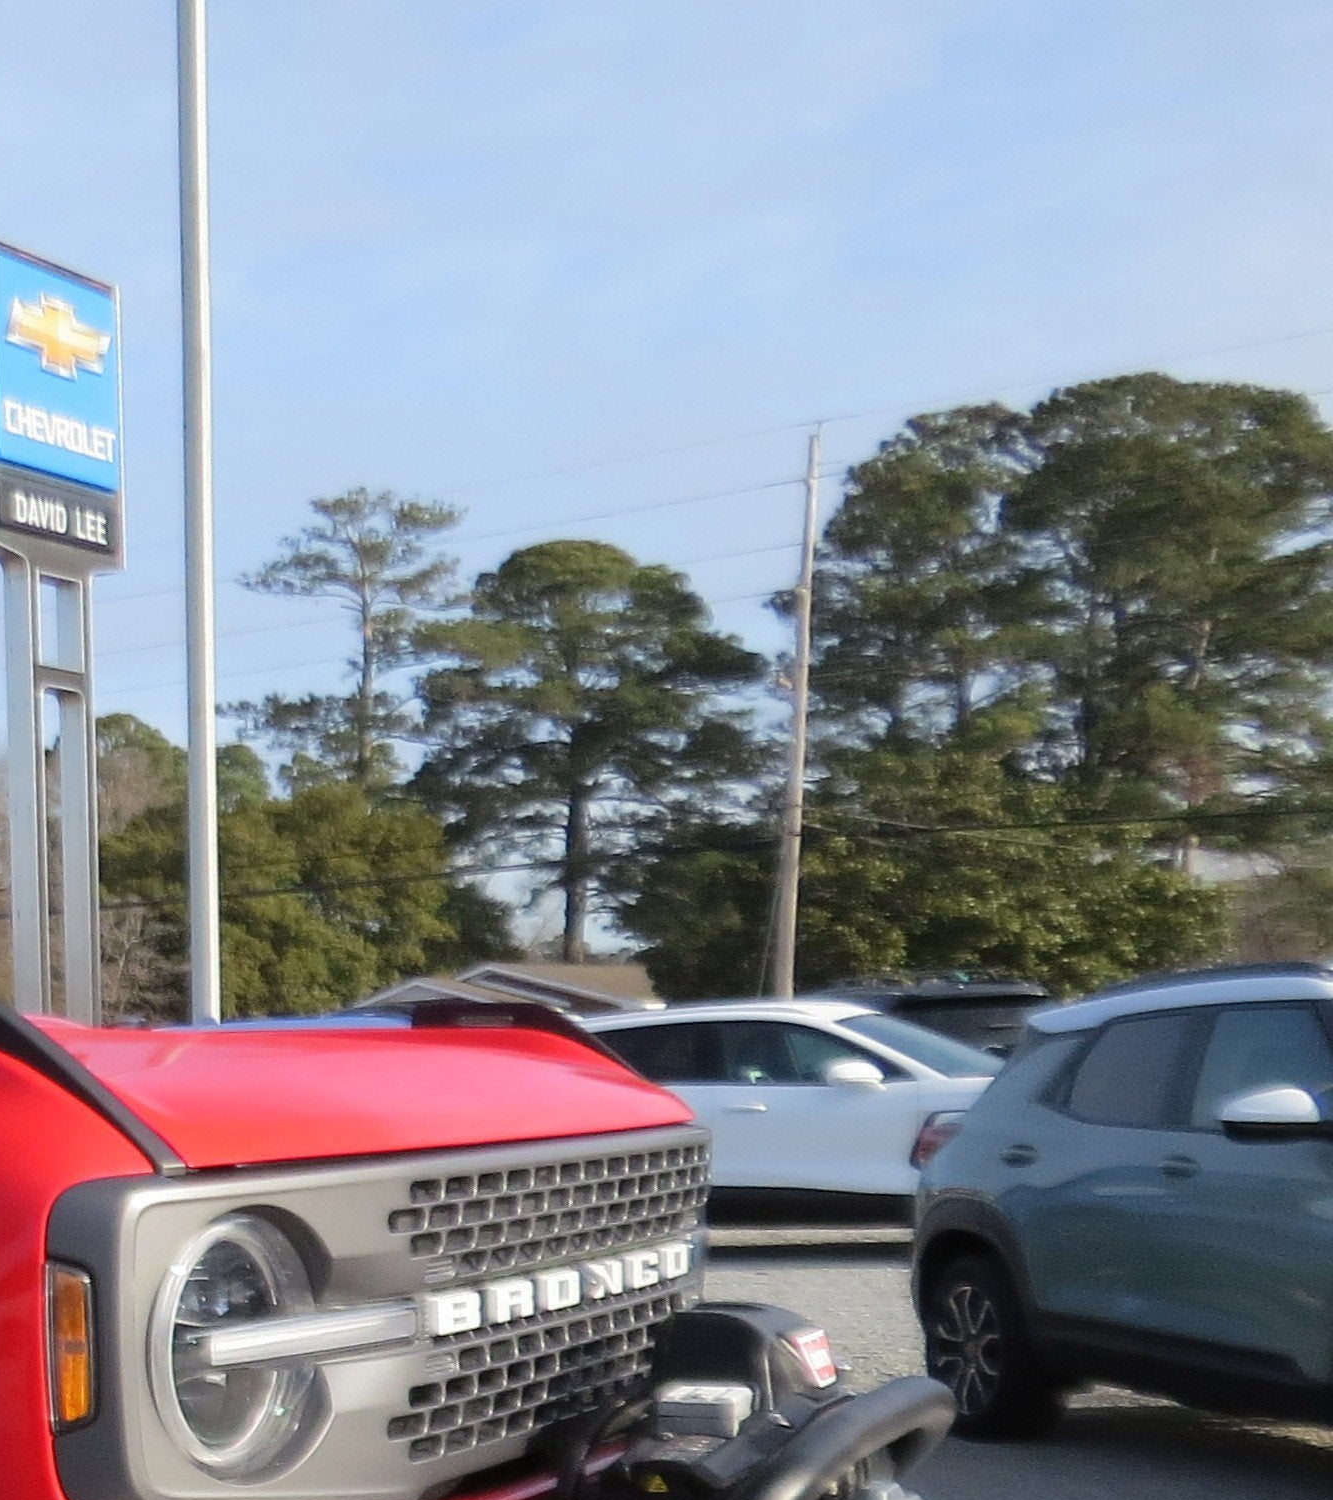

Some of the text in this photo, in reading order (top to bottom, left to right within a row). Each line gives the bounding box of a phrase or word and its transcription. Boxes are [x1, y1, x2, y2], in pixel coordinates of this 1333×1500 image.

[4, 400, 115, 463] CHEVROLET
[14, 492, 108, 546] DAVID LEE
[426, 1243, 694, 1337] BRONCO
